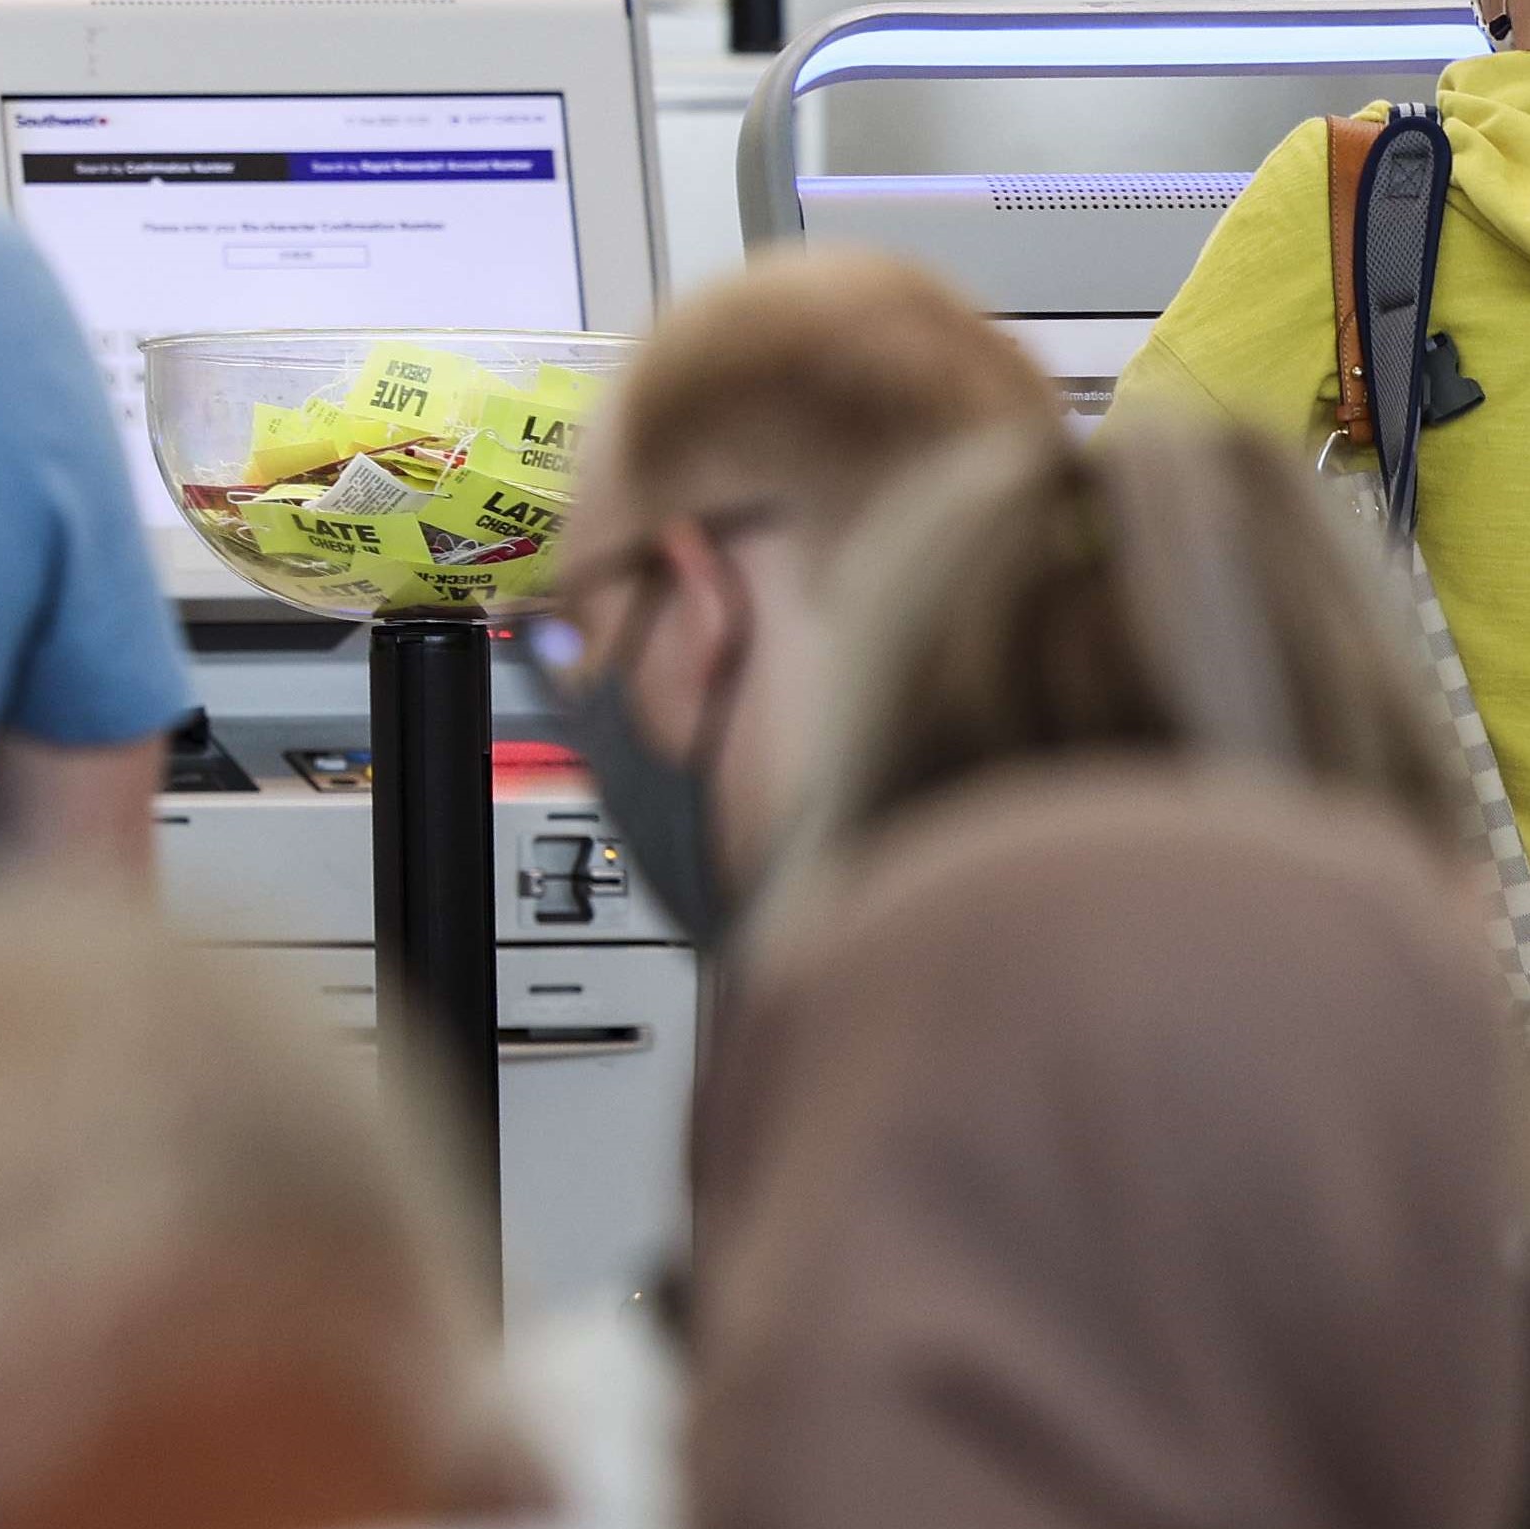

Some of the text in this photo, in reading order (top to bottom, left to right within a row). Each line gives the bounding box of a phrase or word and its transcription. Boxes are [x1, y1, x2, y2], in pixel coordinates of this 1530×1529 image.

[369, 379, 429, 418] LATE
[521, 415, 588, 449] LAT
[521, 449, 577, 475] CHECK
[291, 513, 381, 544] LATE
